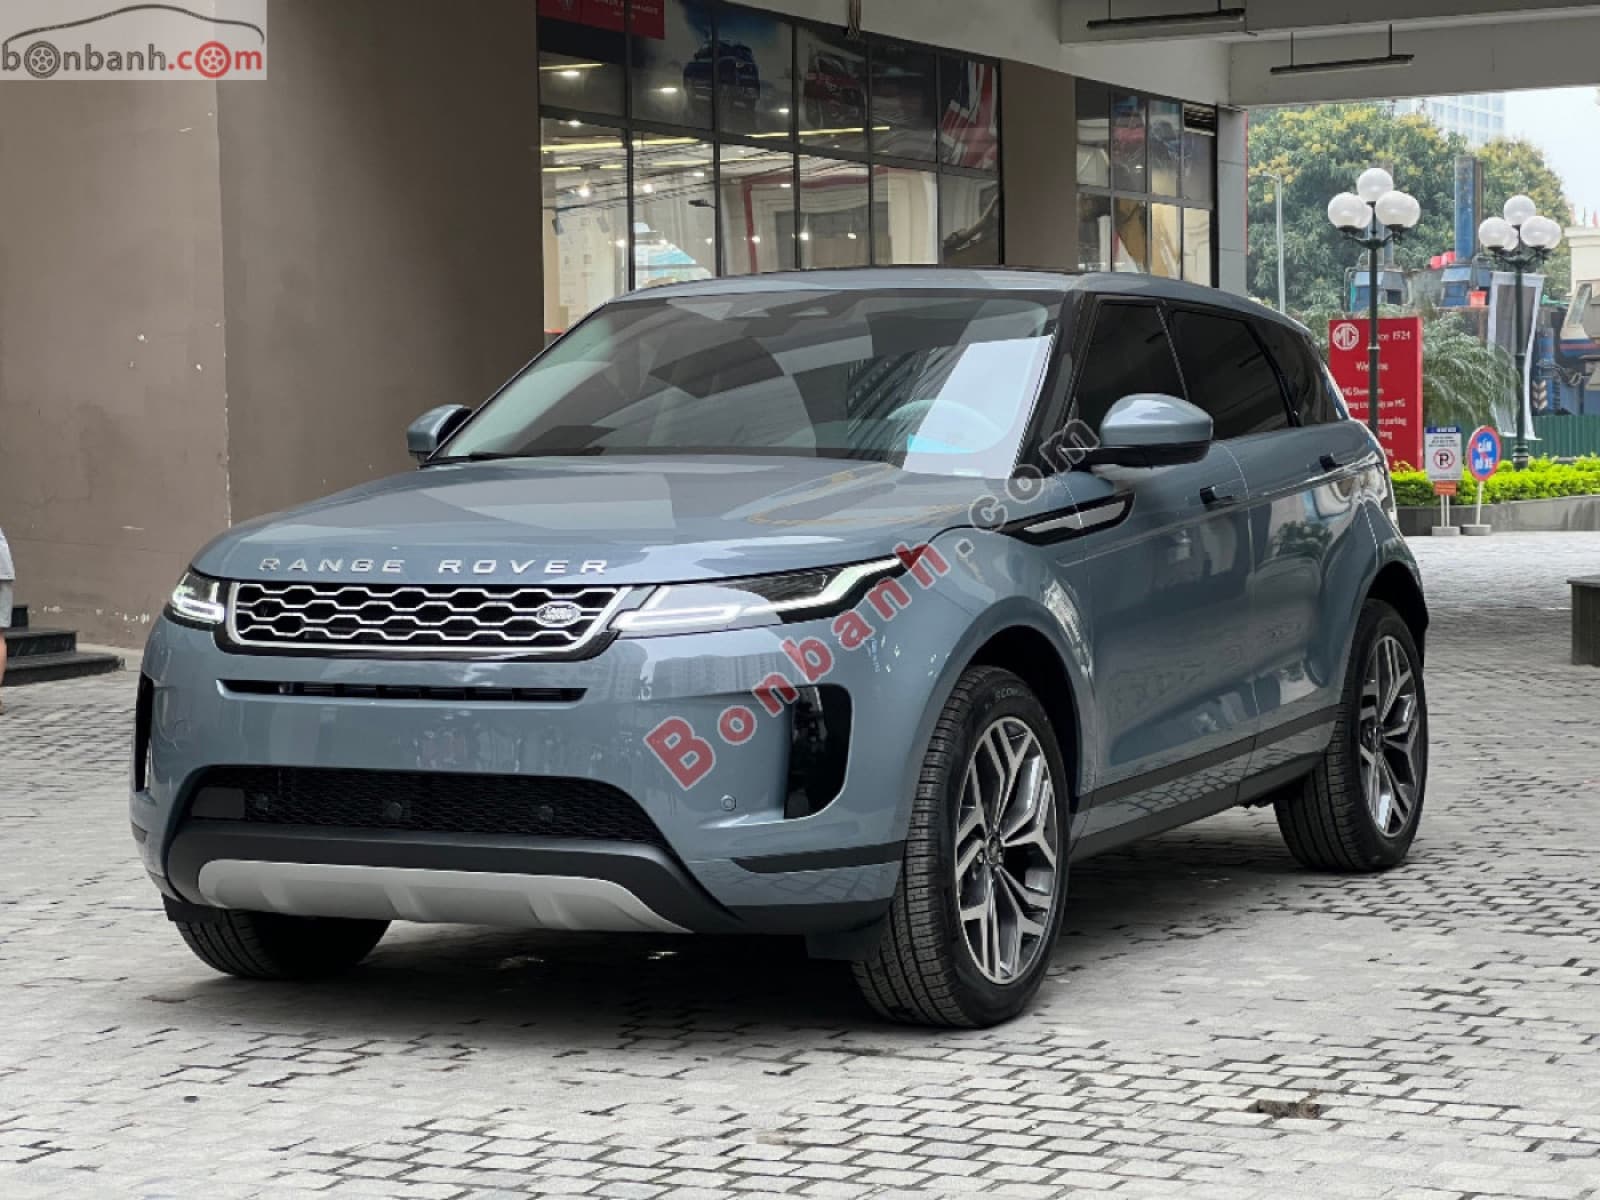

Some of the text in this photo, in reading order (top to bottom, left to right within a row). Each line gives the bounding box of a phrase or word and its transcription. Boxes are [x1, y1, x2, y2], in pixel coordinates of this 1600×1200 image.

[1333, 323, 1359, 350] MG
[258, 557, 608, 575] RANGE ROVER
